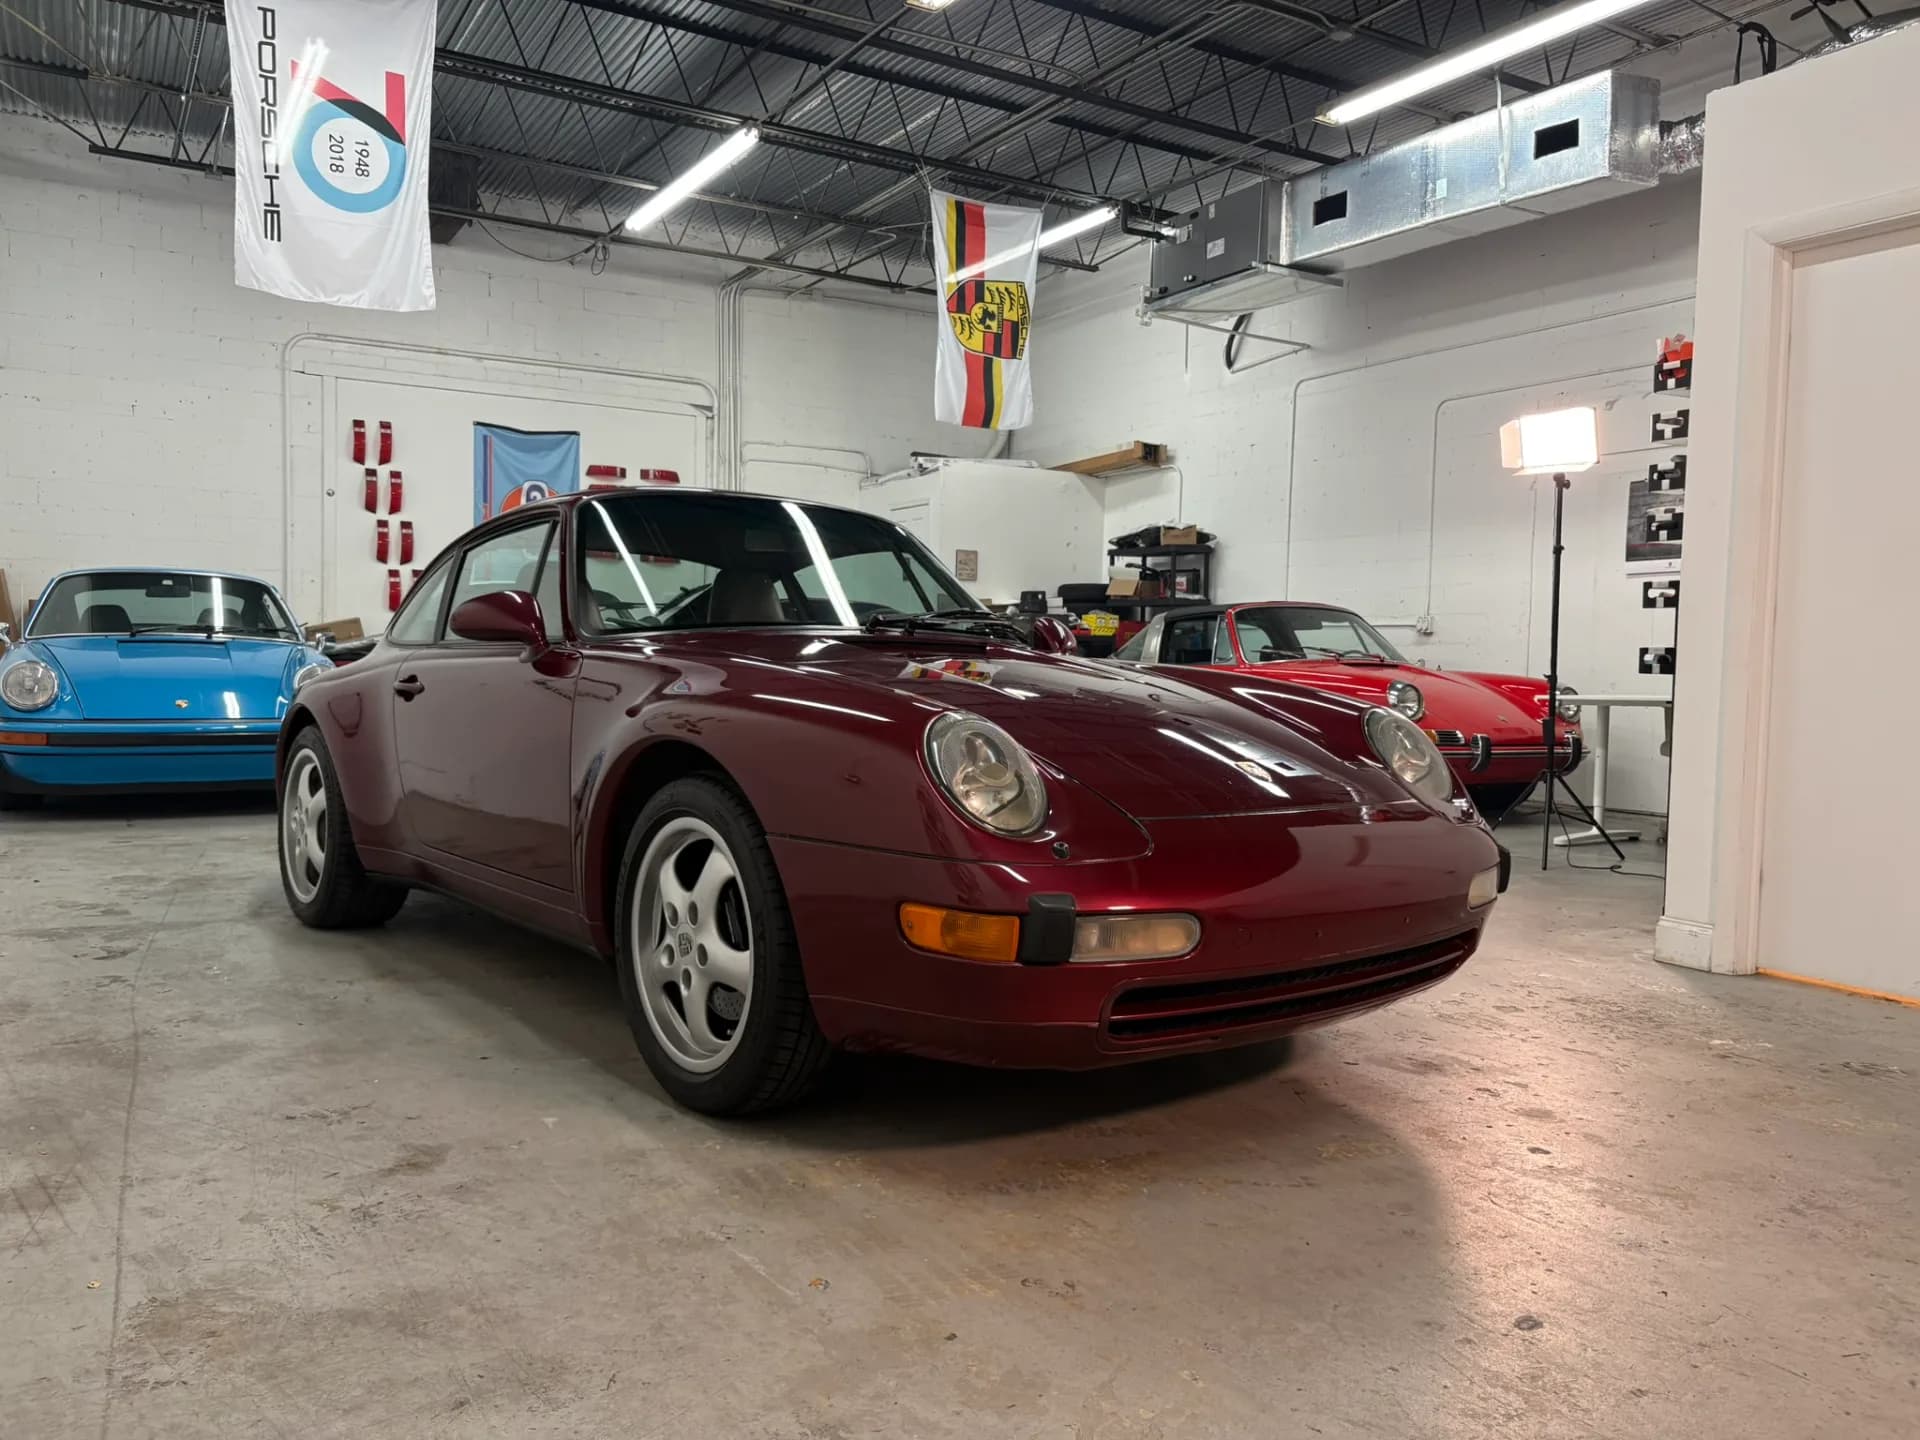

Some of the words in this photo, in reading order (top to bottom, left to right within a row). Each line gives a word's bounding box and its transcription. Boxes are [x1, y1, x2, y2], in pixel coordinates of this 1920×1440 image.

[257, 6, 282, 243] PORSCHE
[328, 133, 345, 174] 2018
[354, 140, 370, 178] 1948
[1018, 284, 1030, 358] PORSCHE
